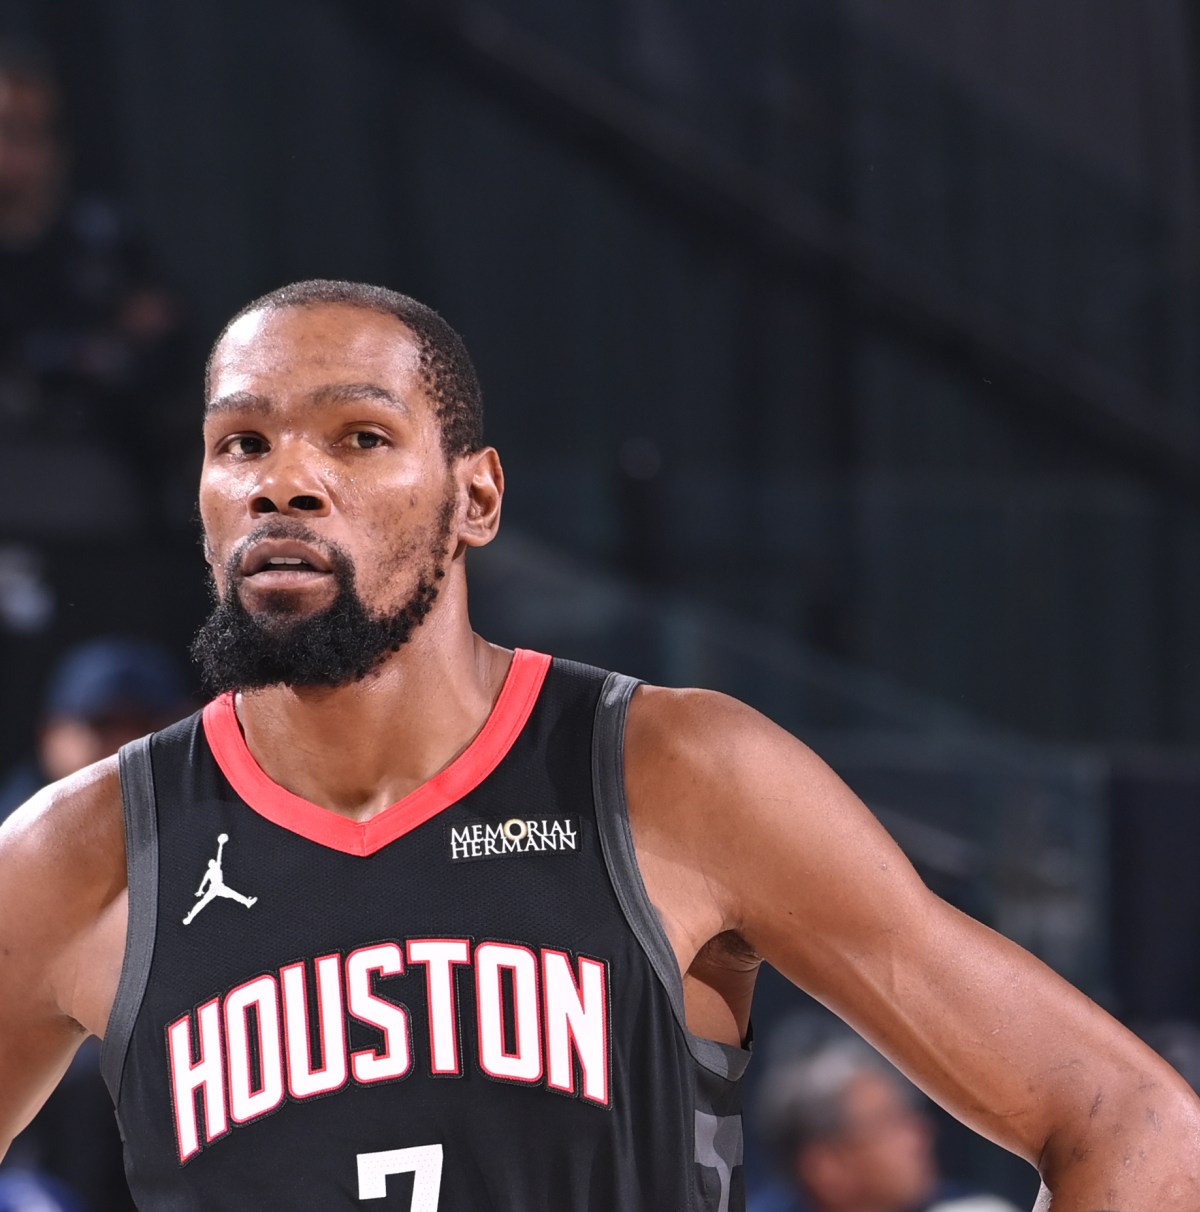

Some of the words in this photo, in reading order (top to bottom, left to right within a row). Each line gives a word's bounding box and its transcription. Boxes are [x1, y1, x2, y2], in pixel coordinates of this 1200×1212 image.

[451, 818, 577, 844] MEMORIAL
[451, 833, 576, 859] HERMANN
[166, 938, 610, 1165] HOUSTON
